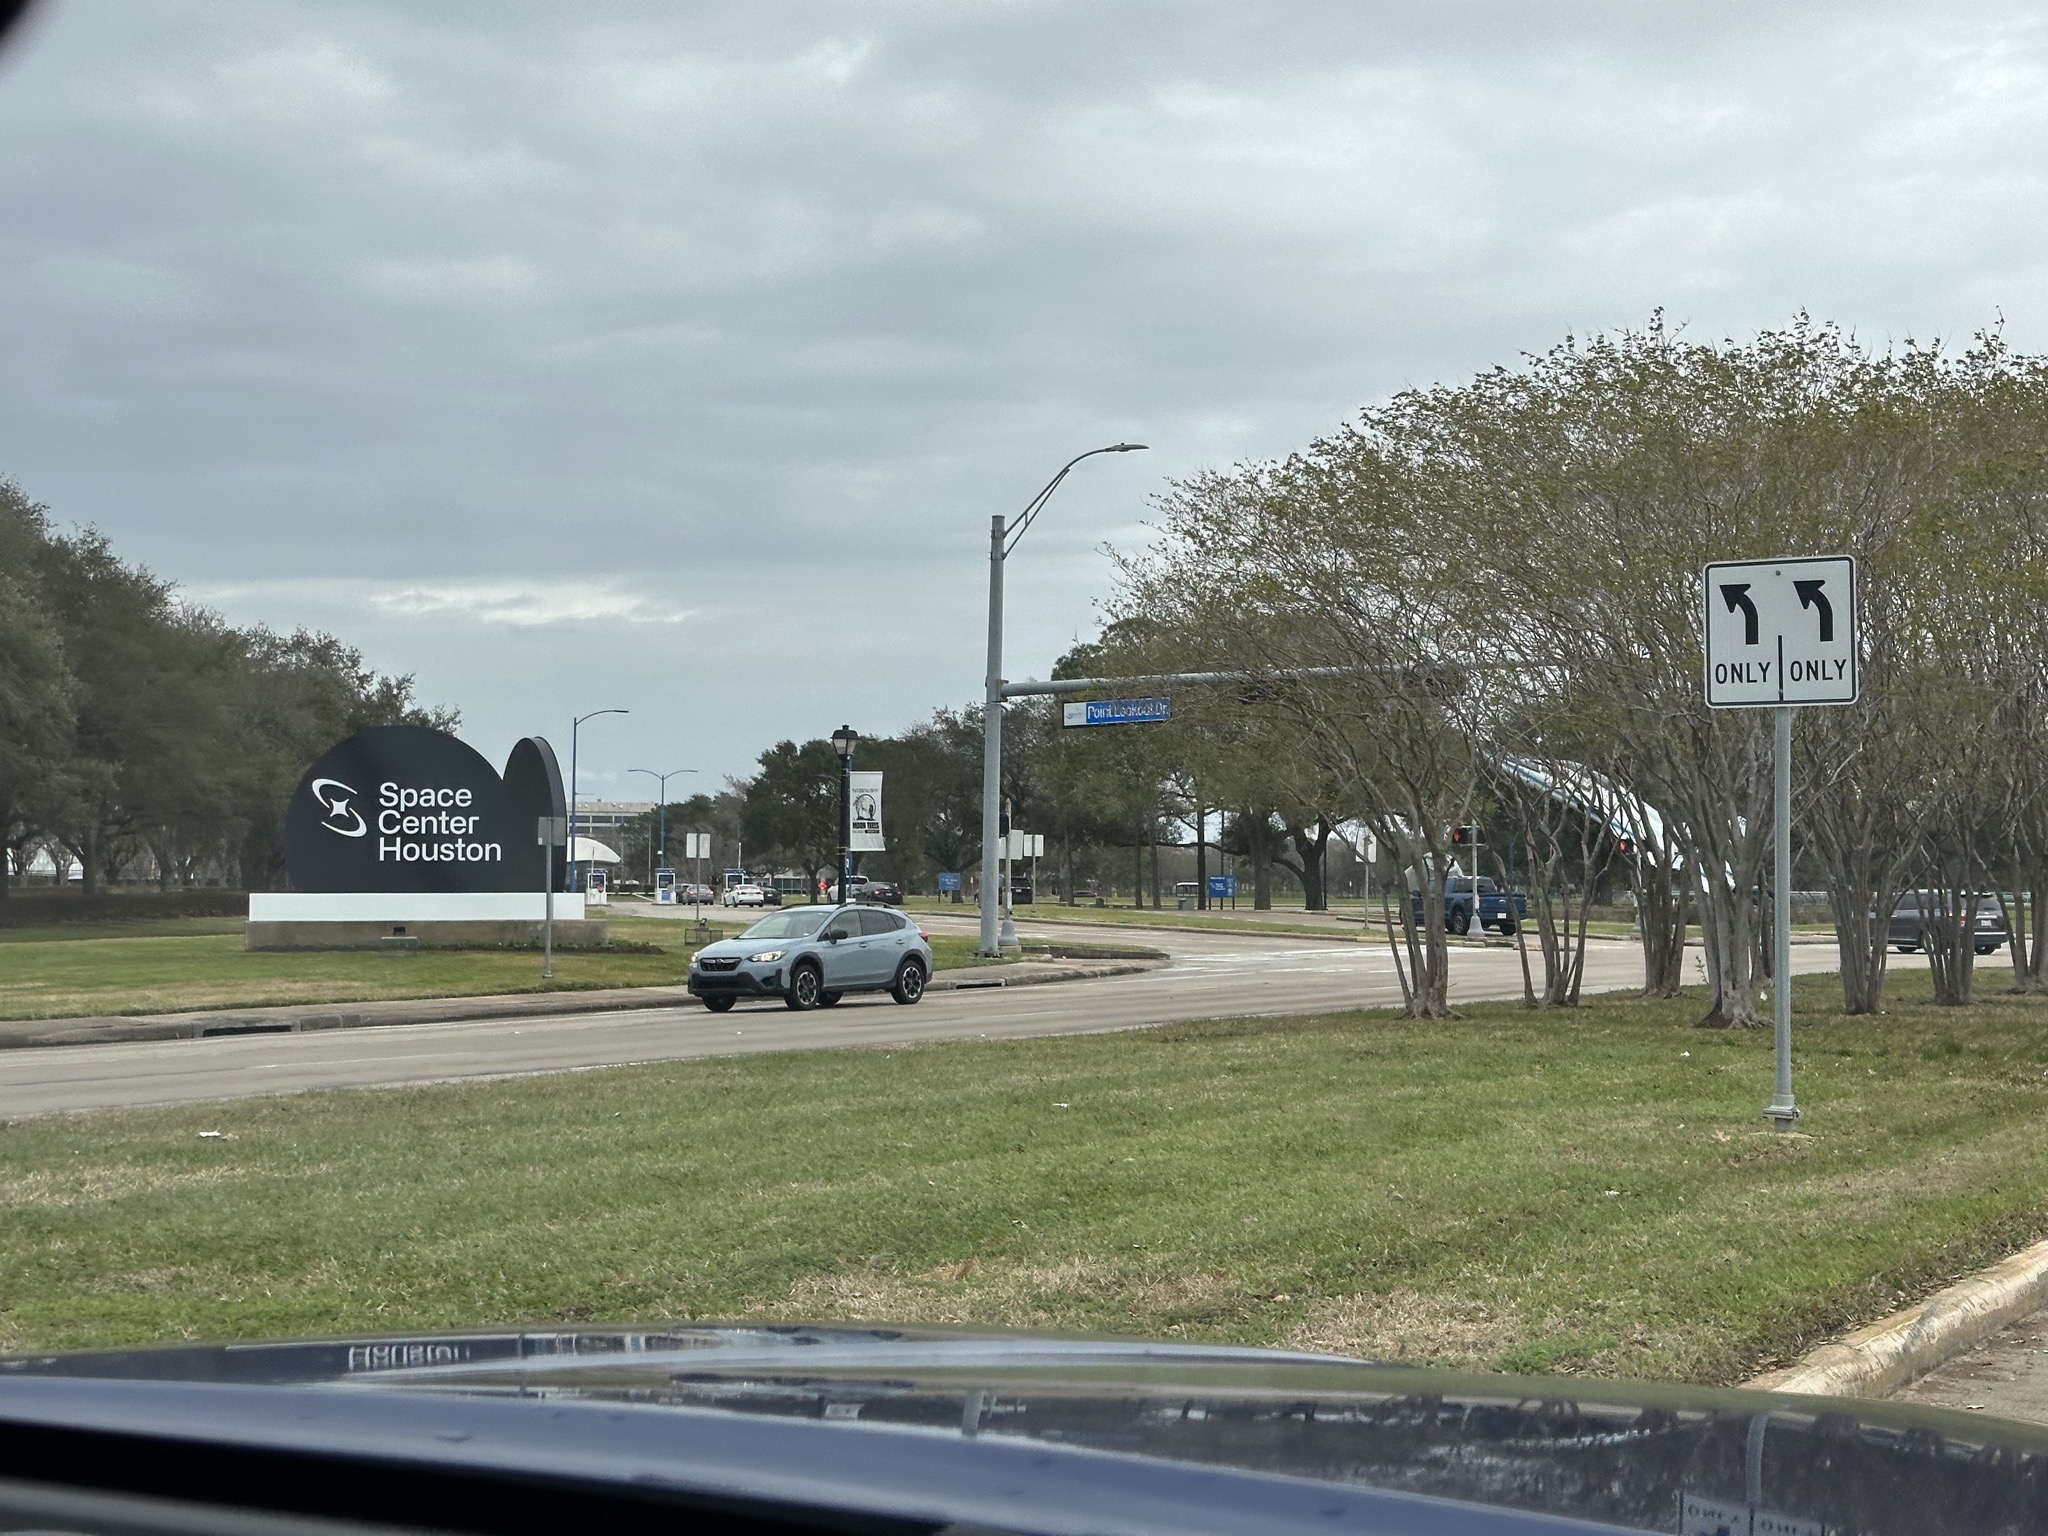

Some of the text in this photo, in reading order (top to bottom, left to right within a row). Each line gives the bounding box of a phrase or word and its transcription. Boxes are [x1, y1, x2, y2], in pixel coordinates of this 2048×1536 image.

[1715, 658, 1847, 685] ONLY ONLY
[1087, 705, 1113, 720] Point
[379, 781, 473, 812] Space
[378, 810, 480, 836] Center
[379, 836, 502, 863] Houston
